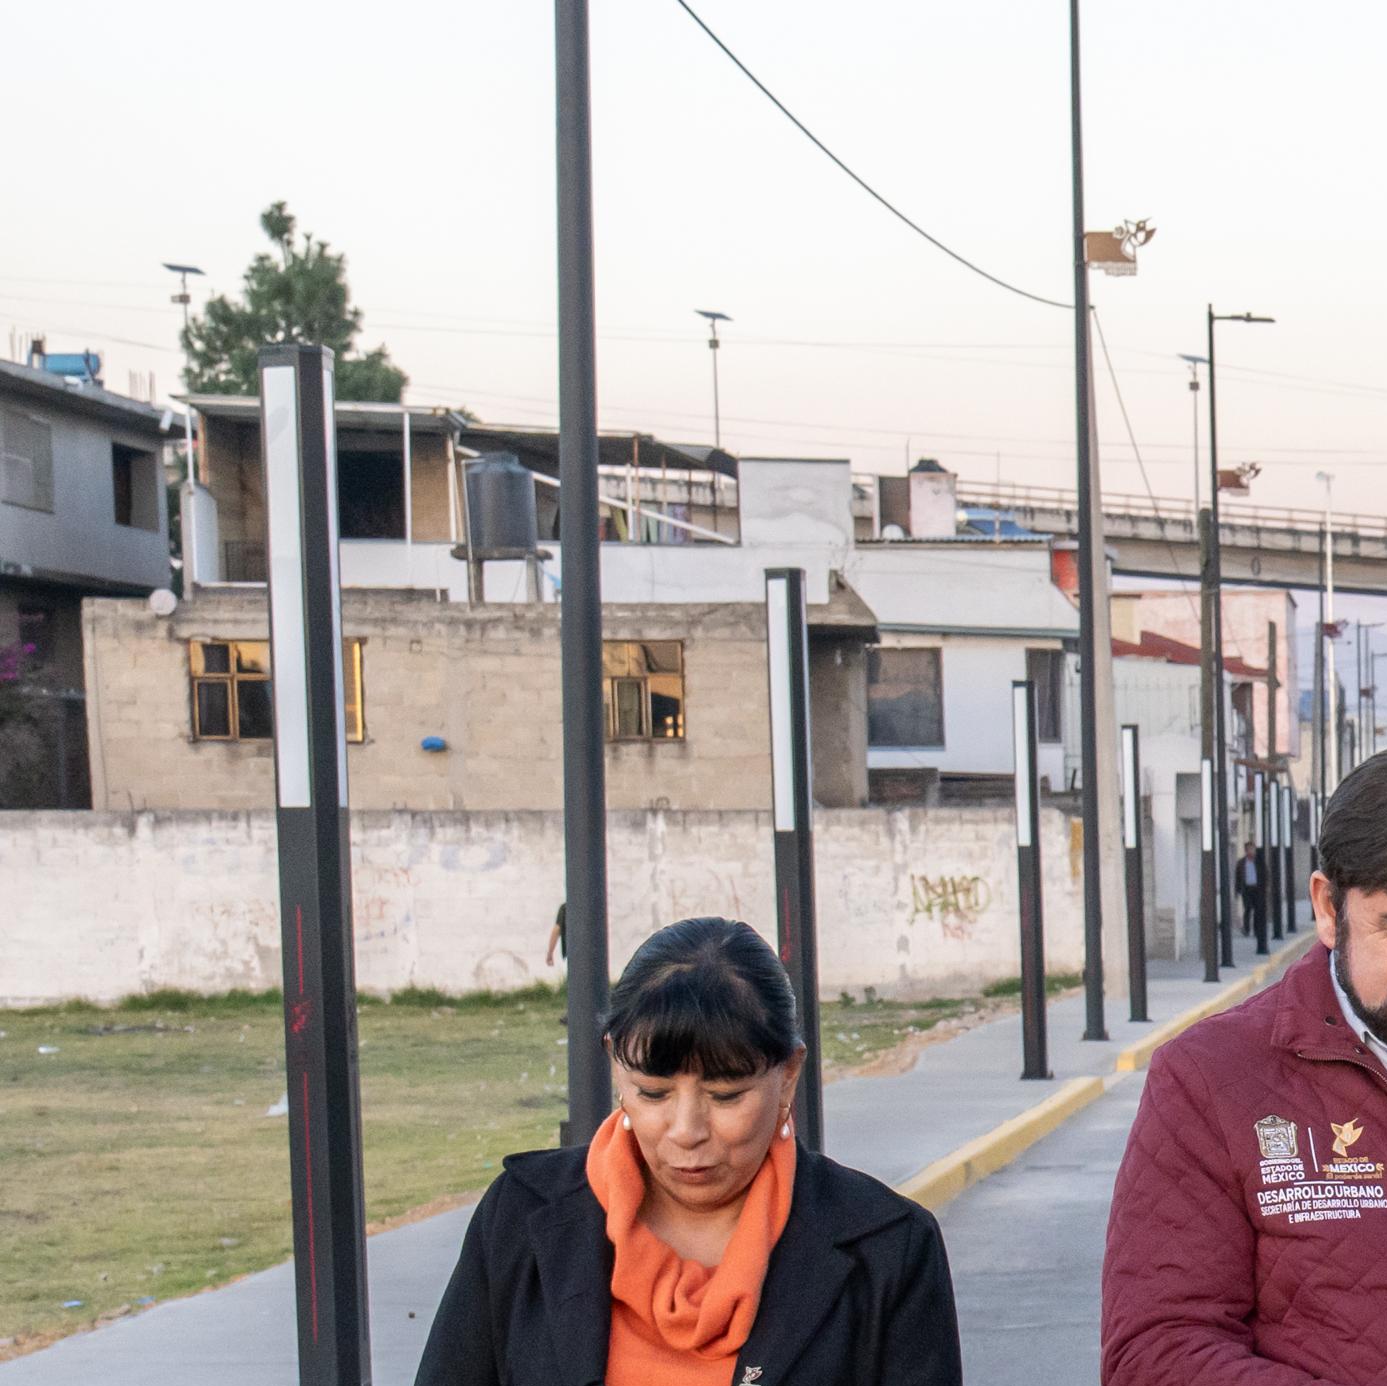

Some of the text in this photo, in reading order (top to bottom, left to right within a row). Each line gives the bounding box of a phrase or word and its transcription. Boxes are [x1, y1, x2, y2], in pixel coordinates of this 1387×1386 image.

[1261, 1165, 1293, 1174] ESTADO
[1257, 1186, 1384, 1205] DESARROLLO URBANO
[1260, 1201, 1300, 1216] SECRETARÍA
[1301, 1201, 1312, 1210] DE
[1313, 1199, 1359, 1209] DESARROLLO
[1288, 1209, 1361, 1224] E INFRAESTRUCTURA
